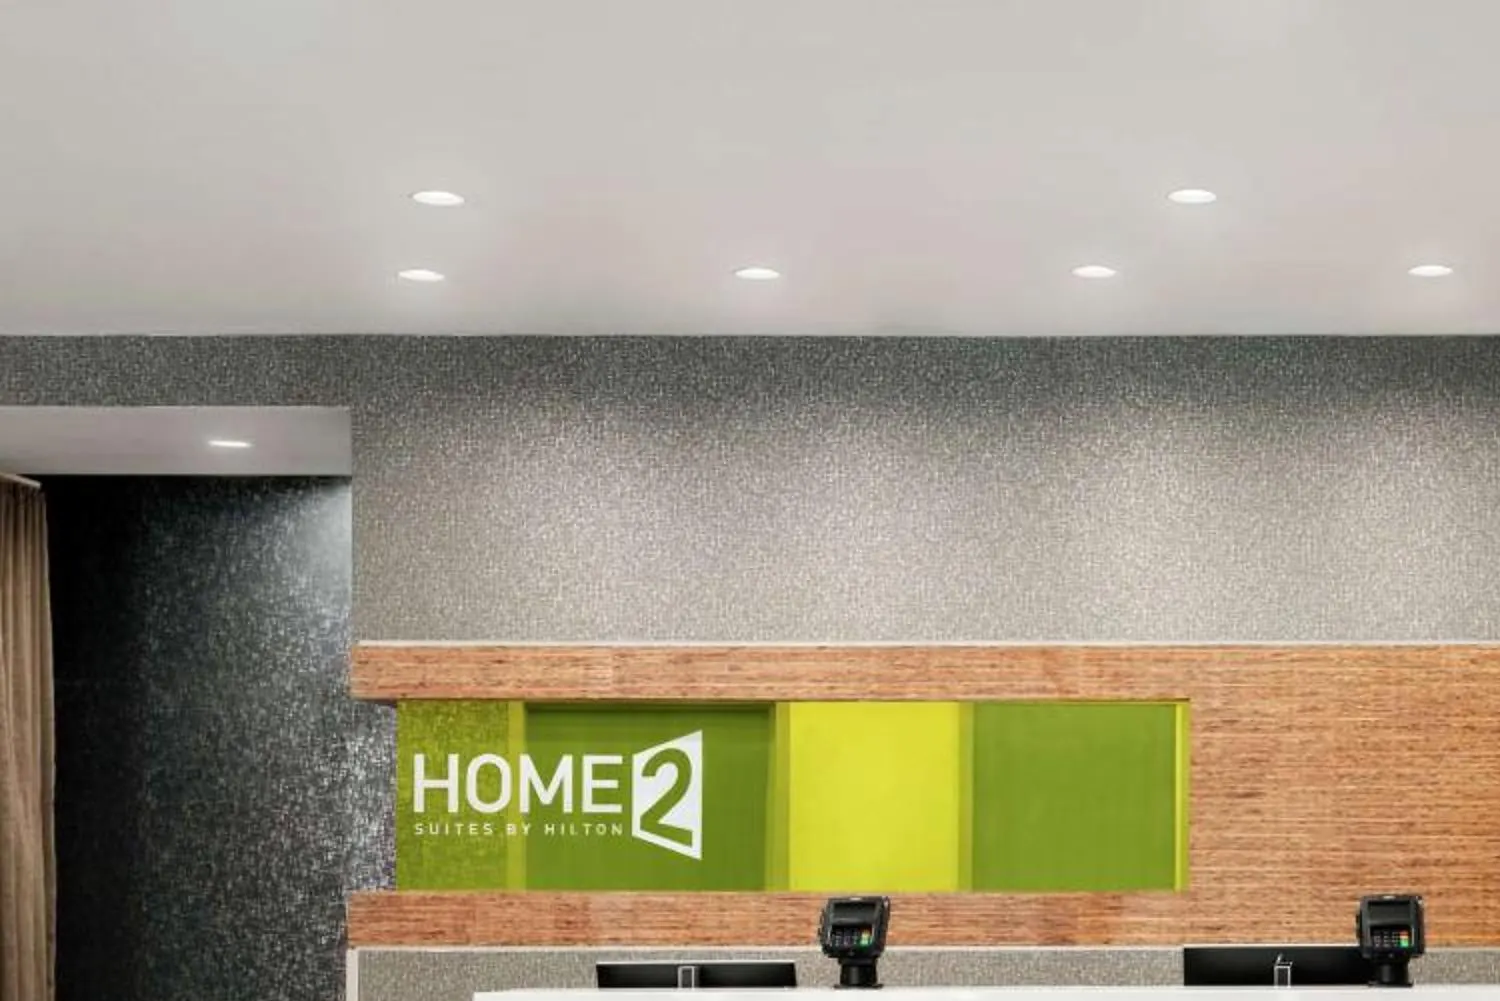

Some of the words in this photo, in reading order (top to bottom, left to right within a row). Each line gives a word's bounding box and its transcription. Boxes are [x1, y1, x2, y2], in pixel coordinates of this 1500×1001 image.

[414, 823, 494, 836] SUITES
[506, 823, 533, 836] BY
[544, 823, 624, 836] HILTON
